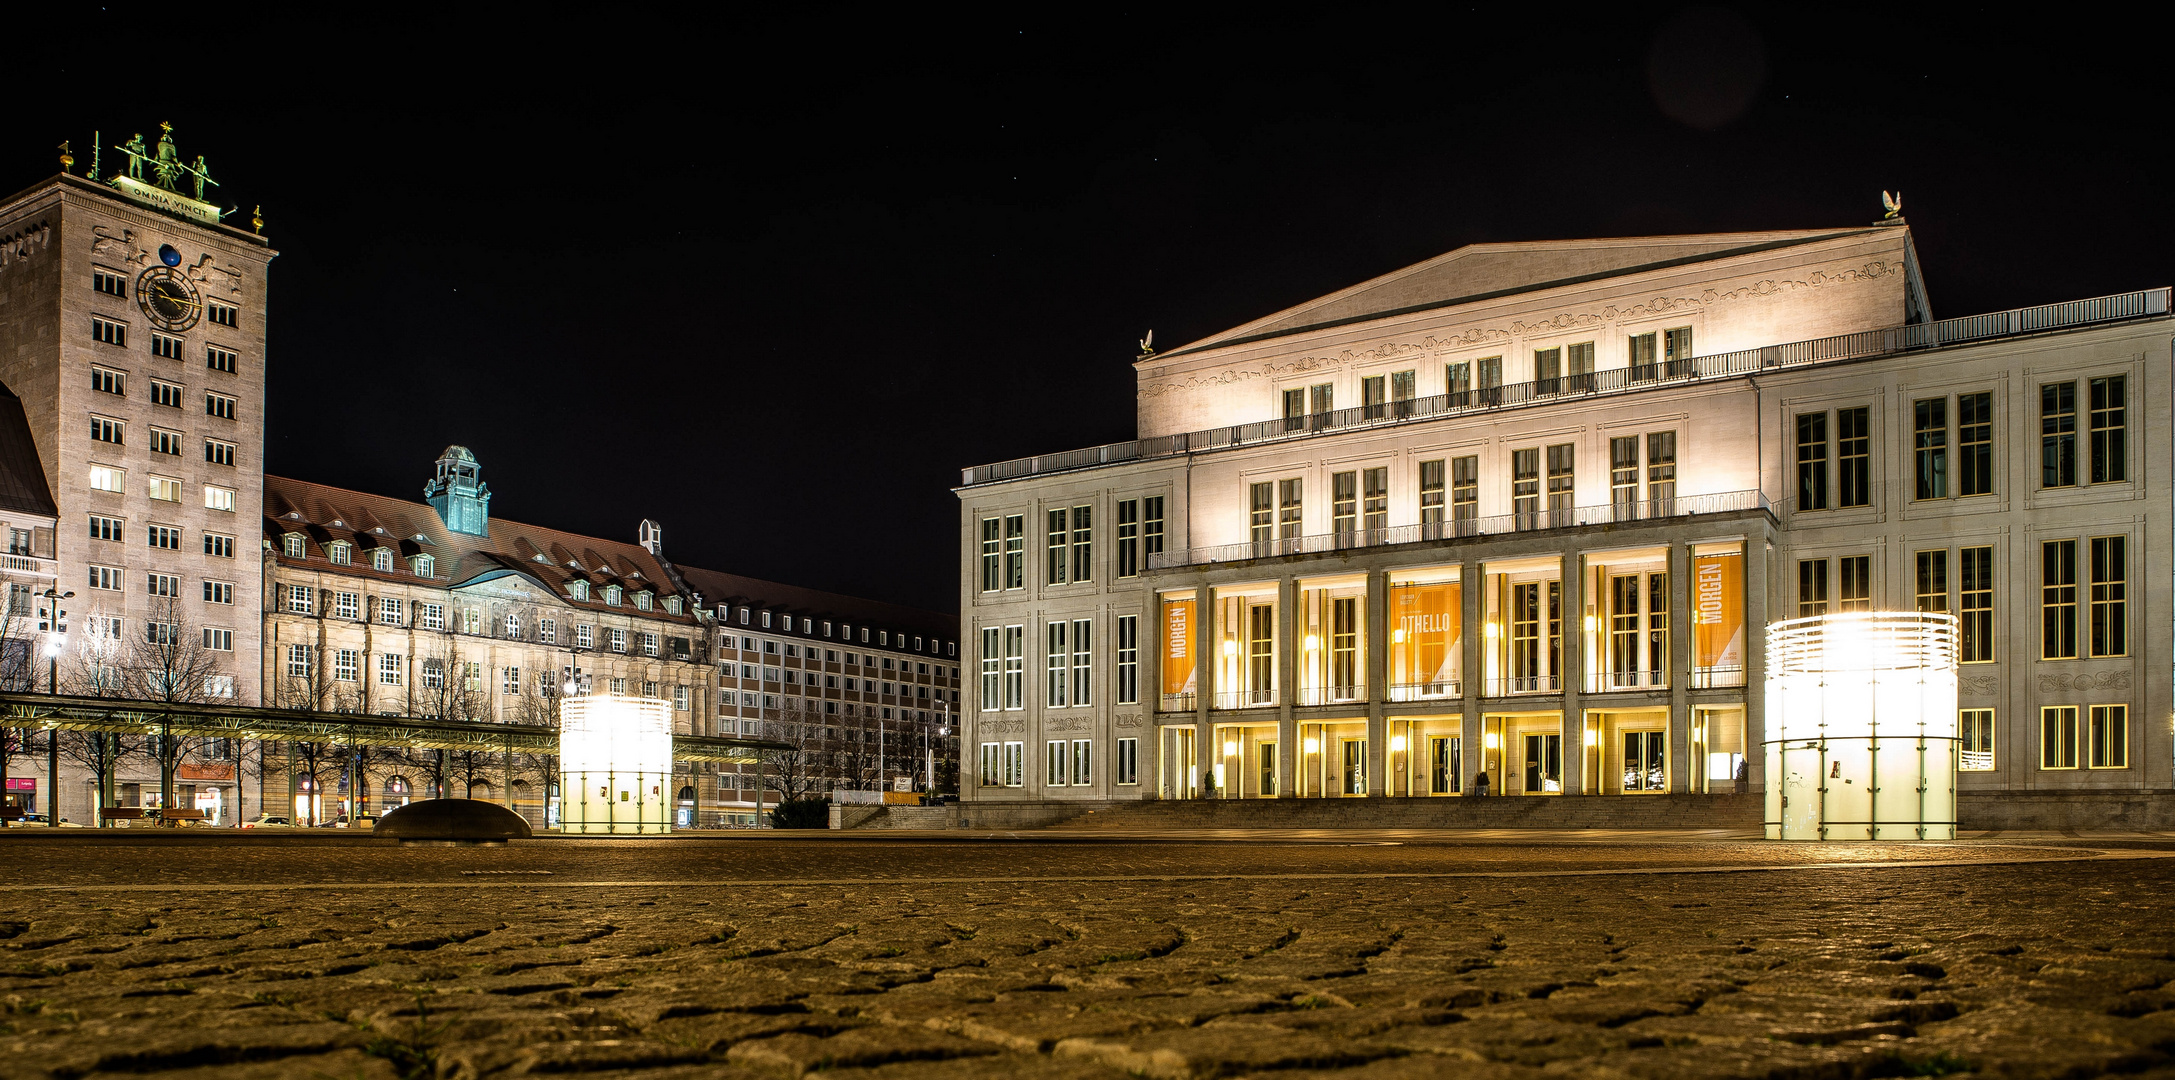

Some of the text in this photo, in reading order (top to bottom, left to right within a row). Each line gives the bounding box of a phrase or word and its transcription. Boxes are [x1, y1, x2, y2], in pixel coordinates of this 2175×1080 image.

[134, 188, 208, 217] OMNIA VINCIT
[1699, 563, 1722, 625] MORGEN
[1170, 607, 1186, 659] MORGEN
[1400, 612, 1450, 635] OTHELLO
